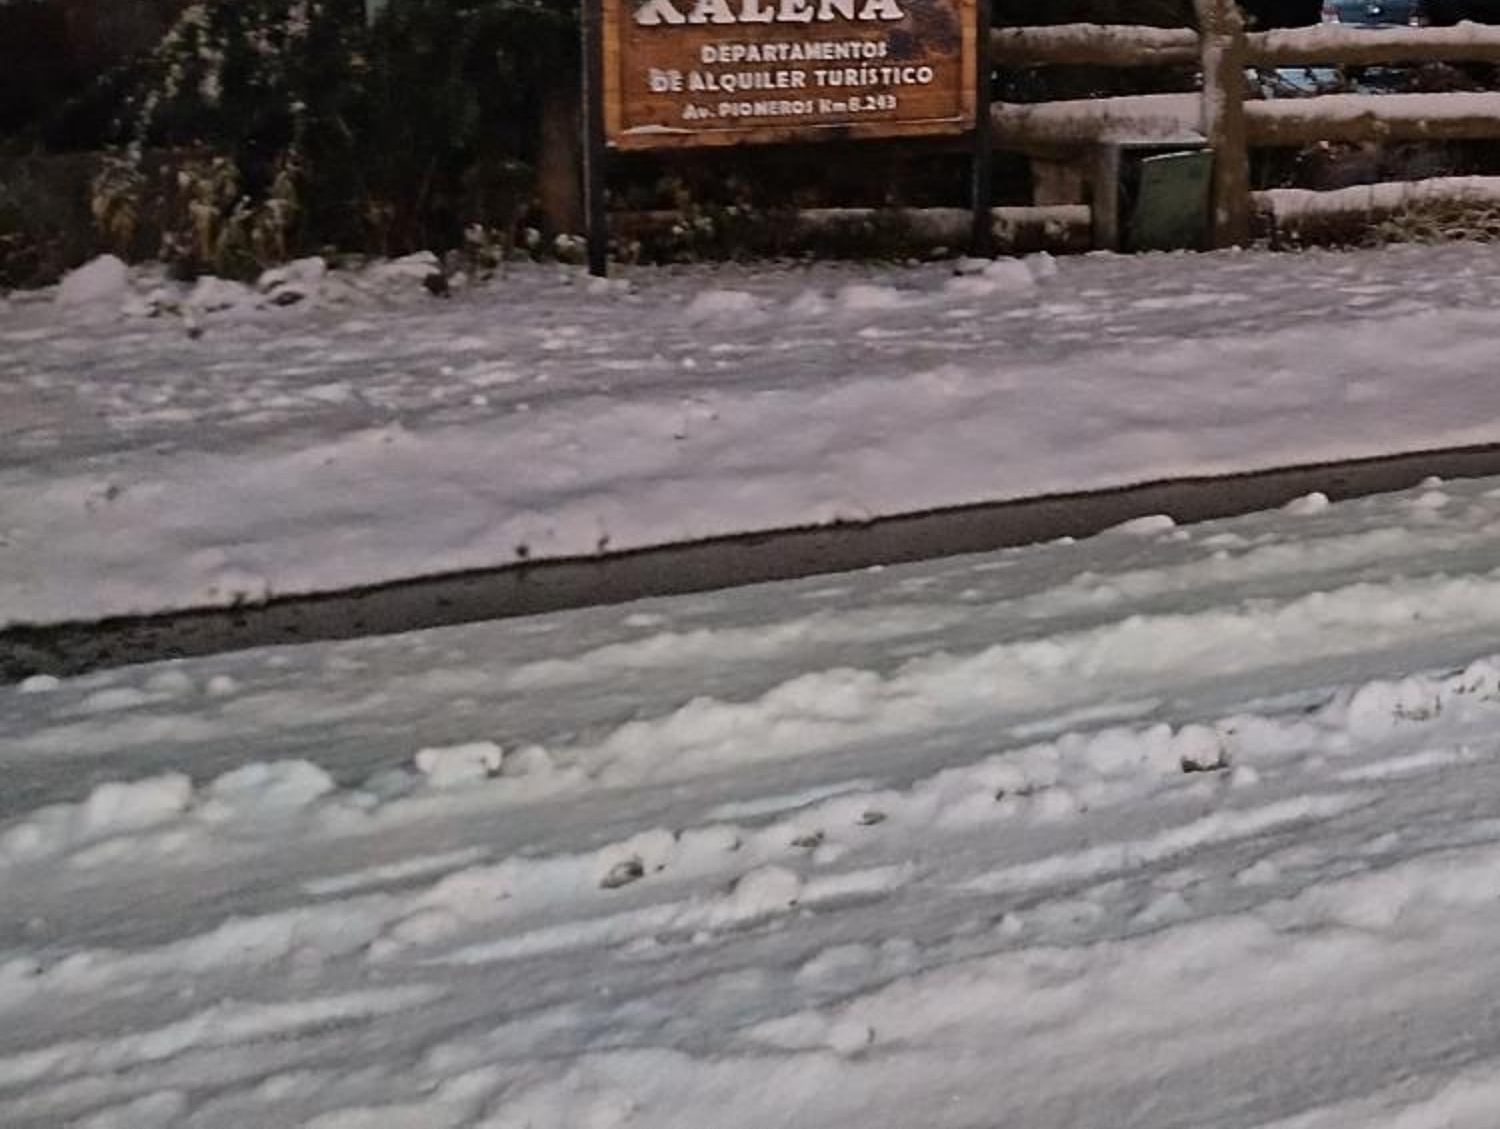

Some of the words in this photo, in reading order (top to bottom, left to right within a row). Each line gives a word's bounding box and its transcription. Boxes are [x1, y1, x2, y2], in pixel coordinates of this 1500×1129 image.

[701, 41, 887, 64] DEPARTAMENTOS
[649, 68, 684, 93] DE
[688, 70, 806, 93] ALQUILER
[814, 62, 934, 87] TURÍSTICO
[717, 99, 813, 118] PIONEROS
